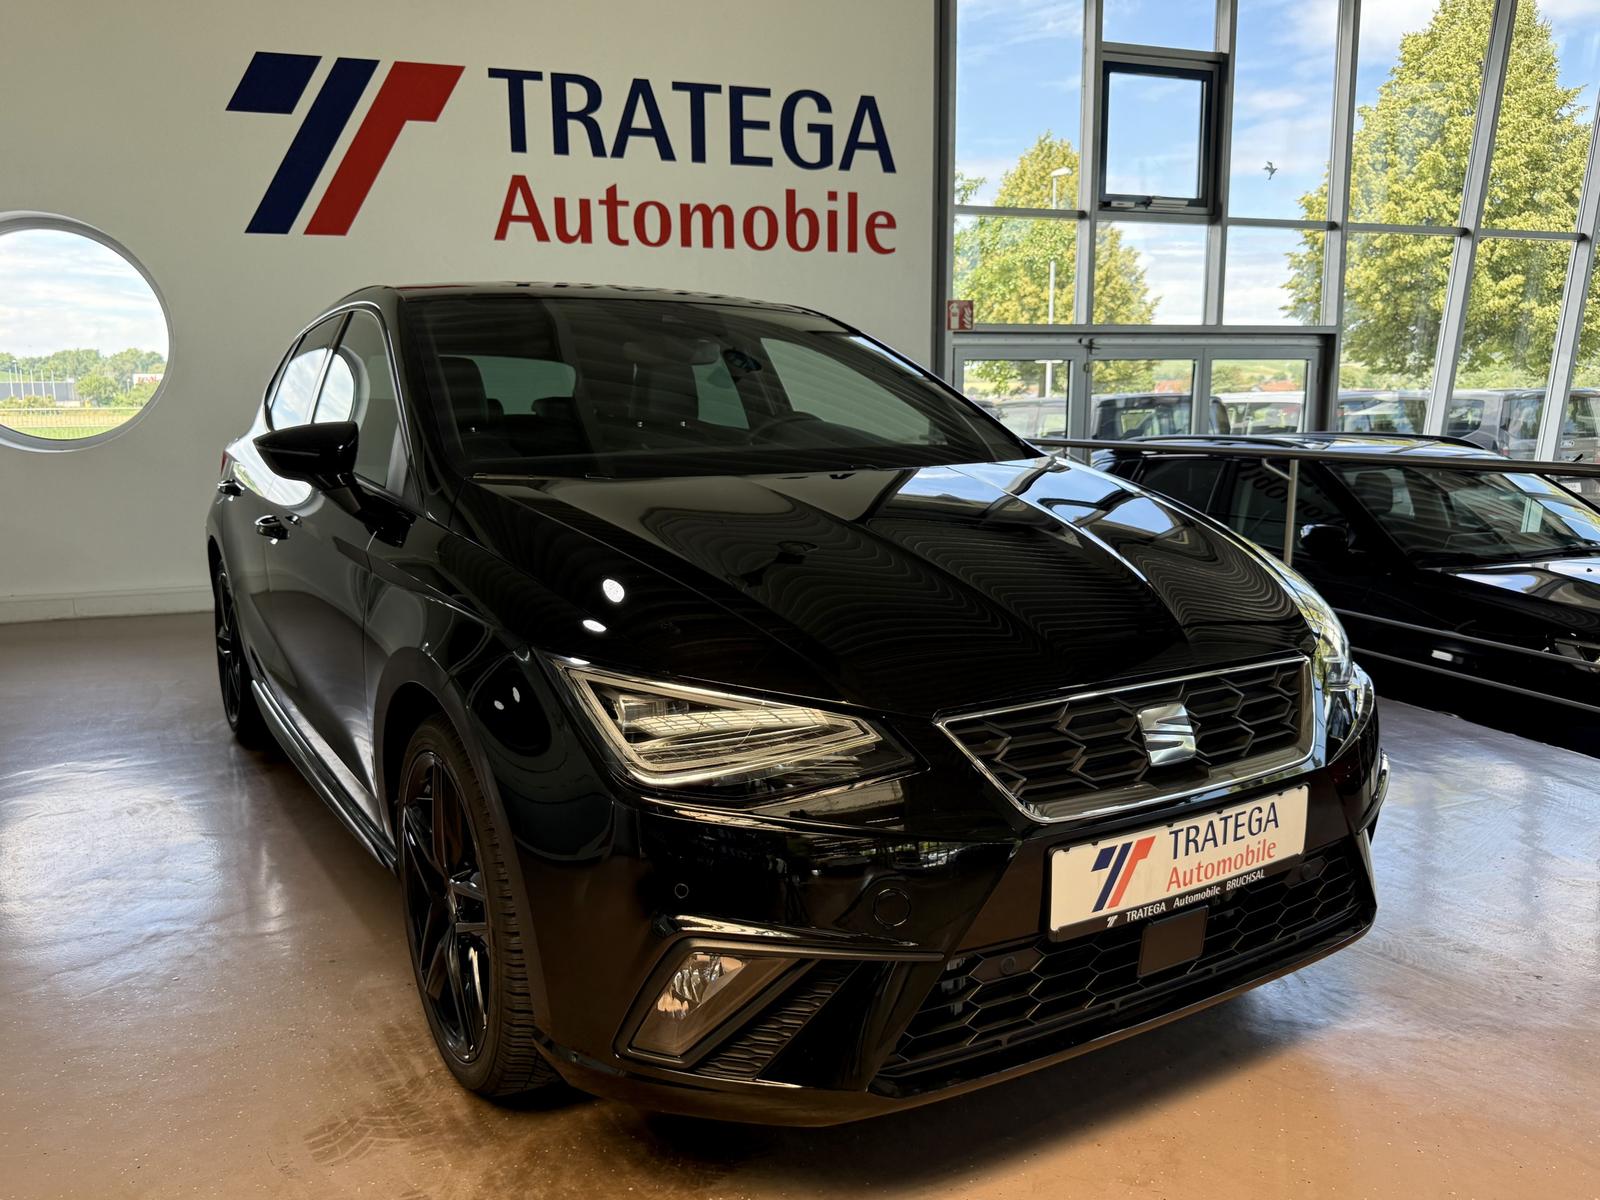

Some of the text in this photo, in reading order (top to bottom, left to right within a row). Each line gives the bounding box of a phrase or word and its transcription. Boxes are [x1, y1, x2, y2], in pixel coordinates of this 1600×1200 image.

[488, 67, 896, 174] TRATEGA
[494, 174, 897, 255] Automobile
[1169, 802, 1279, 860] TRATEGA
[1126, 868, 1265, 922] TRATEGA Automobile BRUCHSAL
[1166, 839, 1277, 893] Automobile
